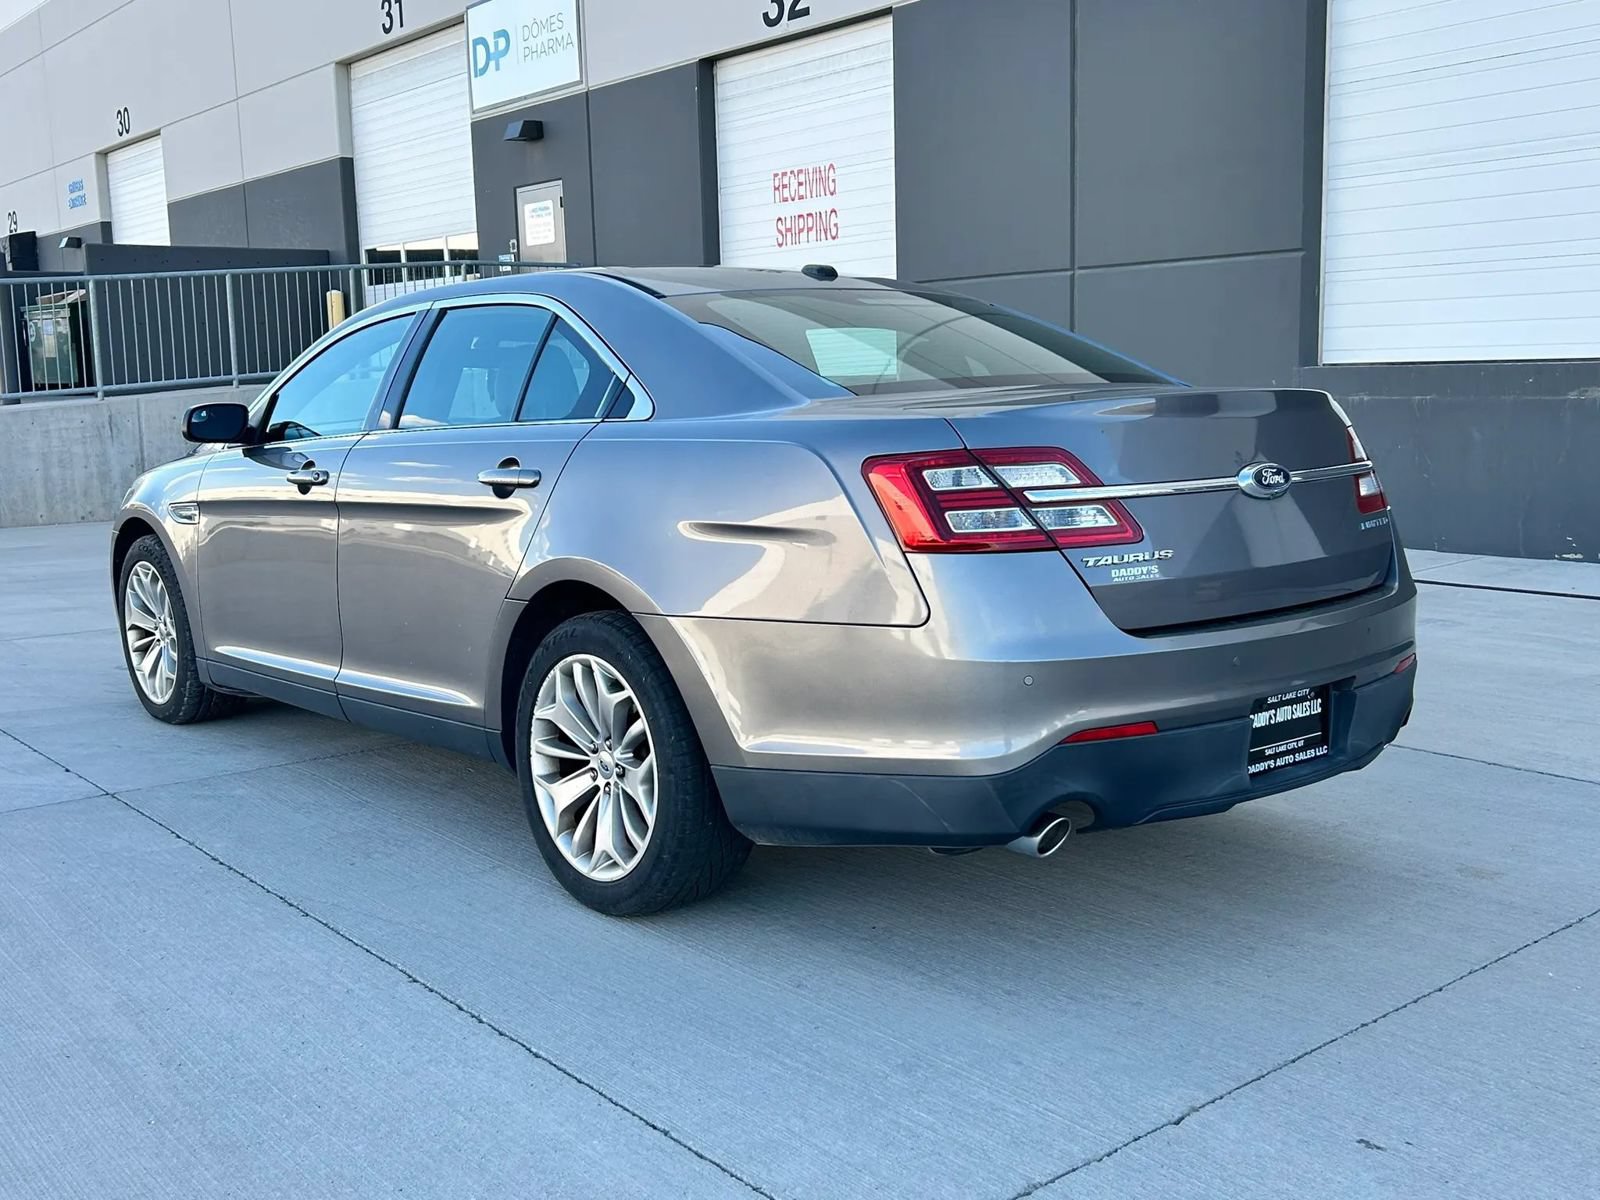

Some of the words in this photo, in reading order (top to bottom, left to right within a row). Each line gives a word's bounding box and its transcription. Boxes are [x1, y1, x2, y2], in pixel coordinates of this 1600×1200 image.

[381, 0, 403, 34] 31
[522, 12, 564, 42] DÔMES
[523, 33, 574, 62] PHARMA
[117, 107, 130, 137] 30
[773, 163, 836, 203] RECEIVING
[8, 211, 17, 233] 29
[776, 208, 839, 248] SHIPPING
[1262, 469, 1285, 485] Ford
[1083, 549, 1174, 568] TAURUS
[1111, 565, 1159, 578] DADDY'S
[1267, 694, 1281, 704] SALT
[1282, 690, 1297, 700] LAKE
[1276, 705, 1292, 723] AUTO
[1292, 701, 1311, 719] SALES
[1311, 698, 1322, 714] LLC
[1264, 747, 1276, 756] SALT
[1276, 743, 1287, 753] LAKE
[1276, 755, 1294, 767] AUTO
[1295, 749, 1315, 762] SALES
[1316, 745, 1328, 756] LLC
